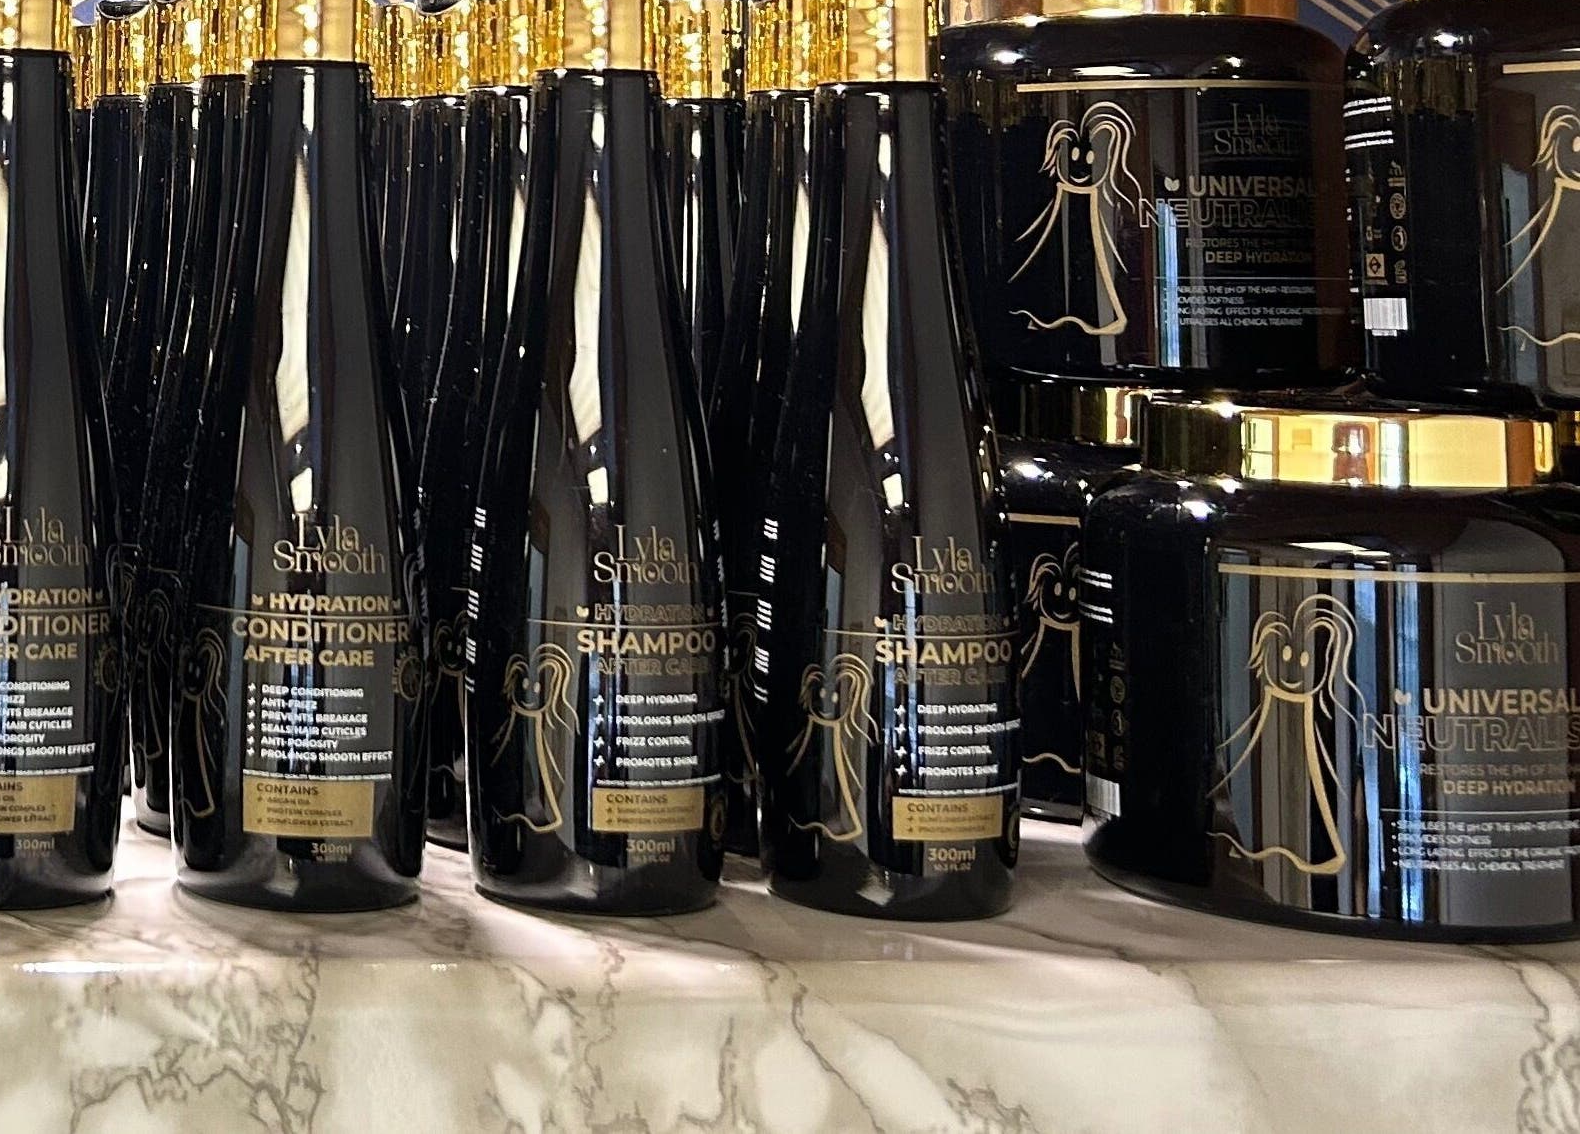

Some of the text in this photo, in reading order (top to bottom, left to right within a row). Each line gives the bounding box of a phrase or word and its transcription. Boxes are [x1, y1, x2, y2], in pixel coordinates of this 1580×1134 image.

[1205, 250, 1242, 264] DEEP
[3, 504, 64, 544] Lyla
[296, 512, 360, 554] Lyla
[614, 523, 676, 563] Lyla
[273, 539, 386, 574] Smooth
[912, 534, 973, 573] Lyla
[593, 551, 702, 584] Smooth
[891, 562, 997, 595] Smooth
[270, 592, 390, 612] HYDRATION
[1475, 601, 1535, 642] Lyla
[232, 616, 410, 644] CONDITIONER
[577, 629, 717, 655] SHAMPOO
[1455, 630, 1560, 665] Smooth
[25, 642, 78, 660] CARE
[244, 644, 375, 666] AFTER CARE
[875, 639, 1012, 665] SHAMPOO
[596, 657, 663, 676] AFTER
[894, 667, 961, 686] AFTER
[0, 681, 70, 691] CONDITIONING
[261, 684, 364, 698] DEEP CONDITIONING
[261, 697, 318, 709] ANTI-FRIZZ
[616, 693, 698, 704] DEEP HYDRATING
[24, 706, 74, 717] BREAKAGE
[917, 703, 997, 715] DEEP HYDRATING
[261, 710, 368, 724] PREVENTS BREAKAGE
[616, 713, 707, 725] PROLONGS SMOOTH
[4, 720, 27, 730] HAIR
[29, 719, 73, 730] CUTICLES
[261, 723, 367, 736] SEALS HAIR CUTICLES
[918, 722, 1005, 735] PROLONGS SMOOTH
[261, 736, 338, 748] ANTI-POROSITY
[616, 736, 692, 747] FRIZZ CONTROL
[26, 746, 66, 757] SMOOTH
[68, 742, 96, 754] EFFECT
[261, 748, 393, 762] PROLONGS SMOOTH EFFECT
[918, 745, 992, 756] FRIZZ CONTROL
[616, 755, 699, 768] PROMOTES SHINE
[919, 764, 998, 777] PROMOTES SHINE
[257, 783, 319, 796] CONTAINS
[1443, 780, 1575, 795] DEEP HYDRATION
[606, 793, 668, 804] CONTAINS
[907, 802, 968, 813] CONTAINS
[16, 837, 56, 851] 300ml
[311, 842, 352, 855] 300ml
[626, 838, 676, 853] 300ml
[928, 847, 976, 862] 300ml
